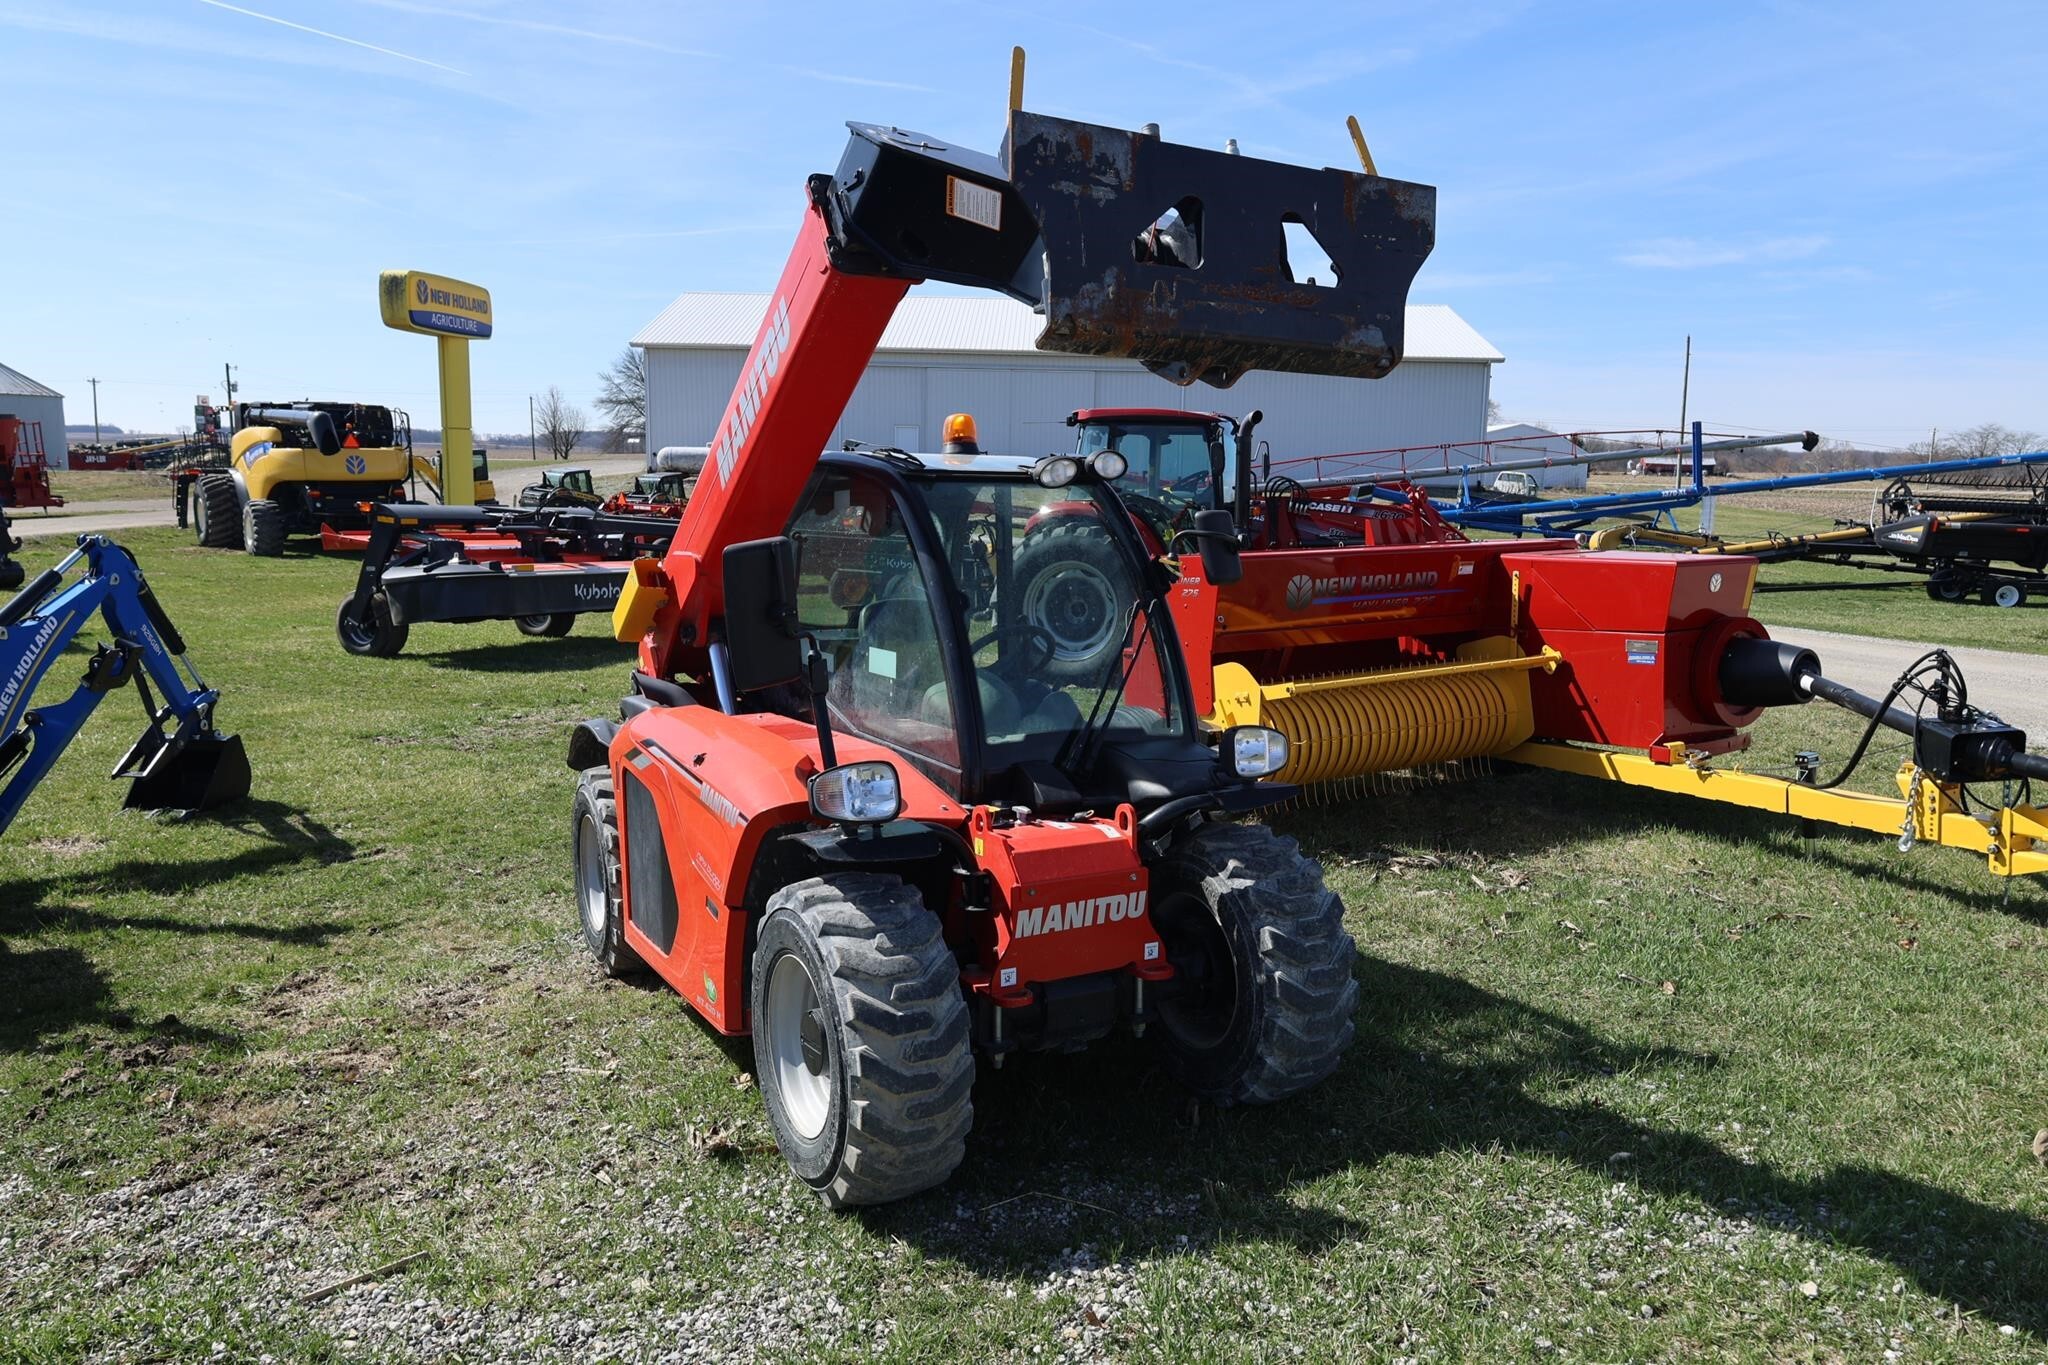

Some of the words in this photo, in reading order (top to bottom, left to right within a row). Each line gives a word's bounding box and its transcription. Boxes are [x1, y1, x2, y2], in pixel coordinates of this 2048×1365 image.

[430, 288, 451, 306] NEW
[452, 293, 488, 314] HOLLAND
[431, 313, 478, 332] AGRICULTURE
[716, 294, 791, 491] MANITOU
[1182, 588, 1200, 598] 275
[1314, 576, 1357, 595] NEW
[1360, 571, 1439, 591] HOLLAND
[0, 678, 19, 716] NEW
[13, 615, 58, 680] HOLLAND
[700, 781, 740, 829] MANITOU
[1015, 890, 1148, 939] MANITOU
